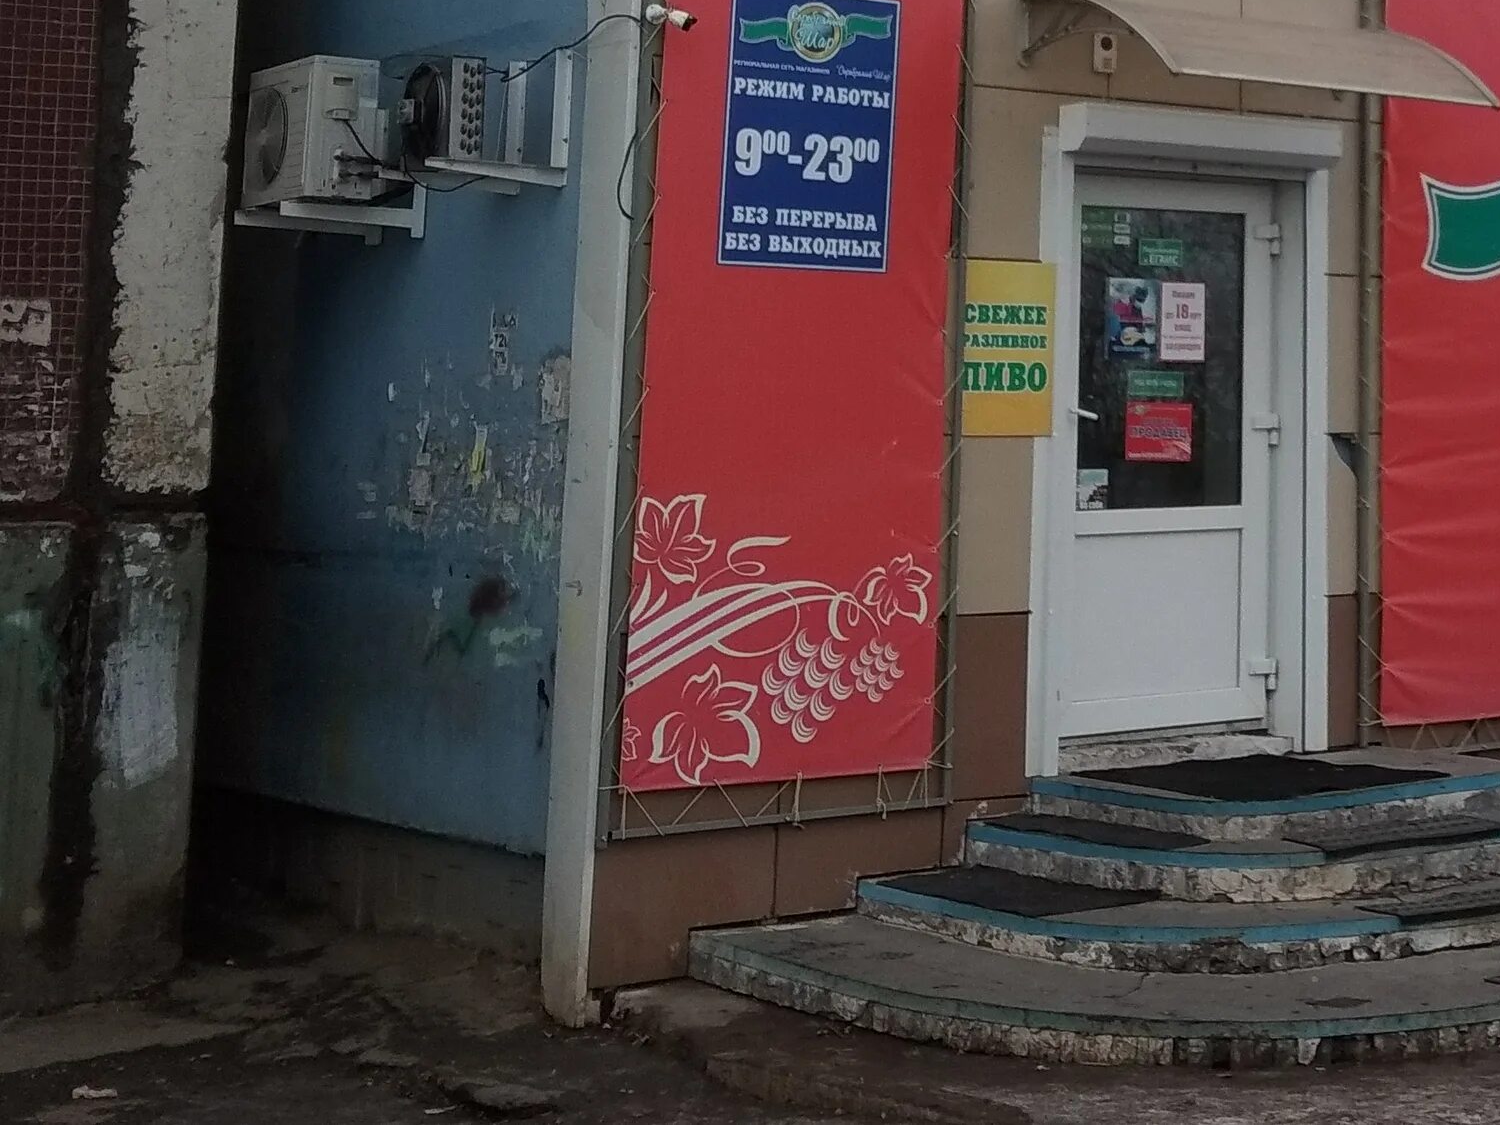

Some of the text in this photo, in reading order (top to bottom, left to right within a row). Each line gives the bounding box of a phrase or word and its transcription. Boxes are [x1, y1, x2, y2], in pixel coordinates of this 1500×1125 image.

[733, 77, 891, 109] РЕЖИМ РАБОТЫ
[732, 205, 878, 232] БЕЗ ПЕРЕРЫВА
[725, 232, 882, 259] БЕЗ ВЫХОДНЫХ
[964, 303, 1048, 326] СВЕЖЕЕ
[960, 361, 1048, 392] ПИВО
